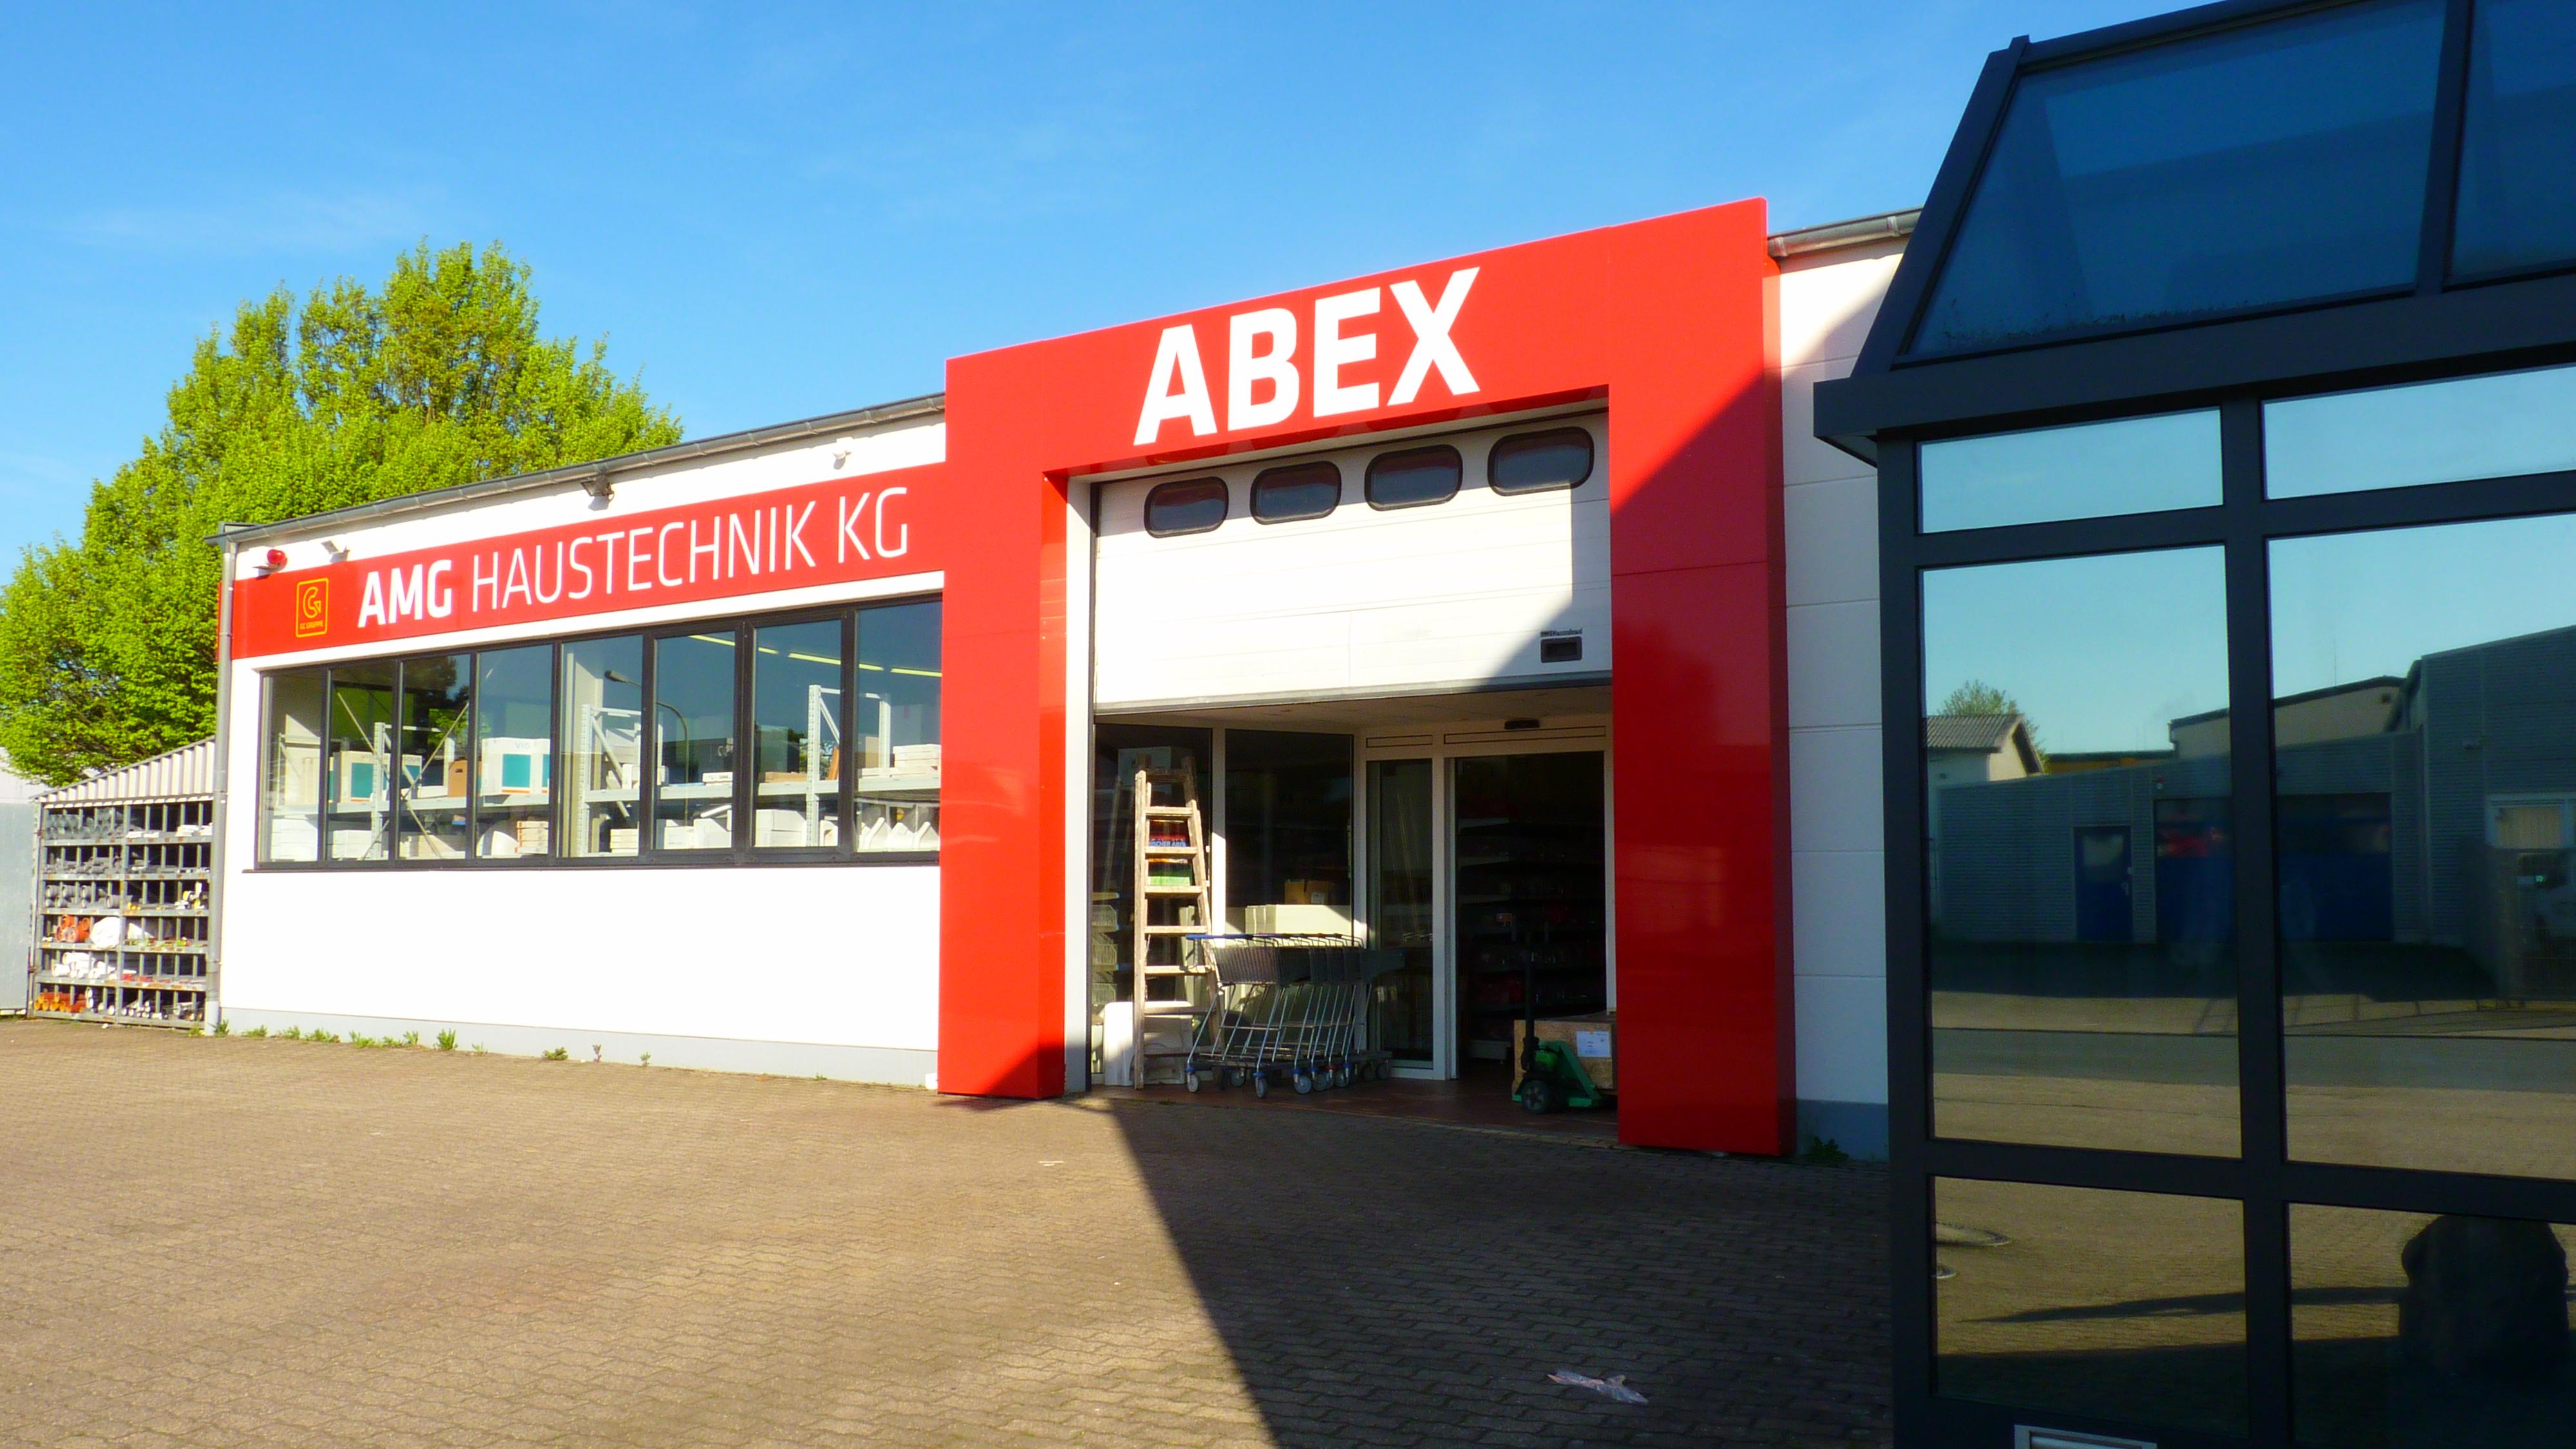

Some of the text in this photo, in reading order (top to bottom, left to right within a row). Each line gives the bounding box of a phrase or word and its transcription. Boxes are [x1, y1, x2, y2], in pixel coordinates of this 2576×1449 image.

[1133, 266, 1481, 447] ABEX
[357, 486, 908, 629] AMG HAUSTECHNIK KG
